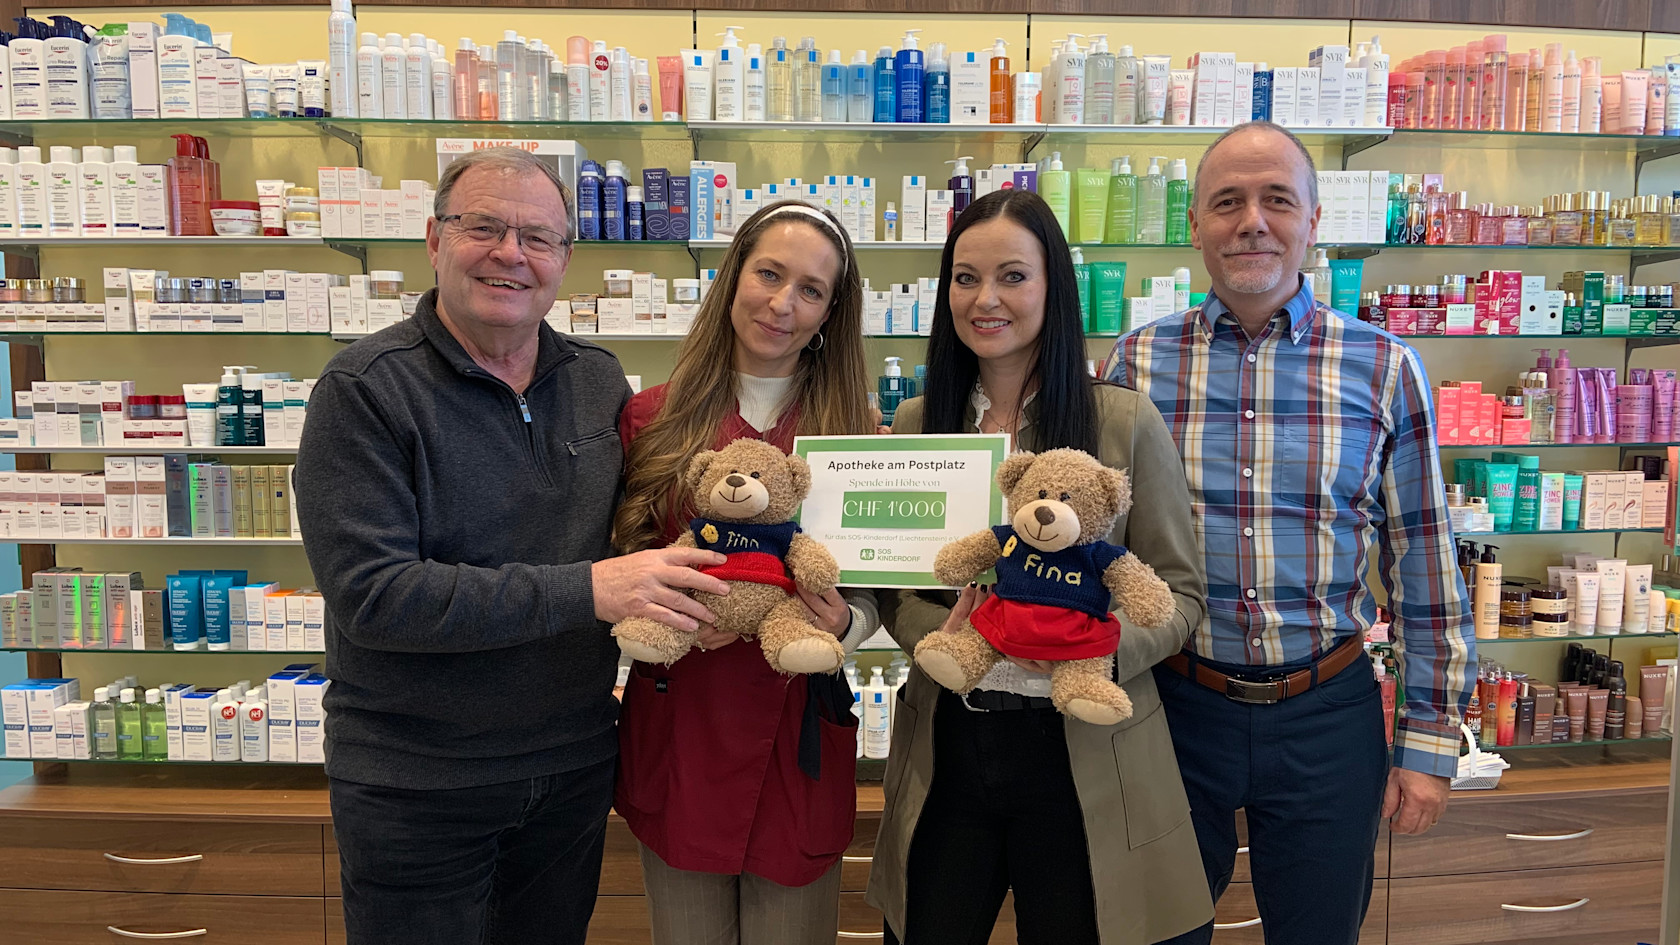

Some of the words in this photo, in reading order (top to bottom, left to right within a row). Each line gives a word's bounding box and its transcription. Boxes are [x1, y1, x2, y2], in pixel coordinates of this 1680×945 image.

[1067, 58, 1083, 67] SVR
[1325, 53, 1343, 62] SVR
[1098, 59, 1114, 68] SVR
[1347, 72, 1363, 80] SVR
[697, 176, 708, 240] ALLERGIES
[1075, 270, 1089, 280] SVR
[828, 461, 884, 472] Apotheke
[909, 460, 965, 471] Postplatz
[849, 478, 883, 488] Spende
[896, 479, 920, 487] Höhe
[843, 500, 882, 516] CHF
[888, 500, 945, 517] 1'000
[1024, 554, 1081, 586] Fina
